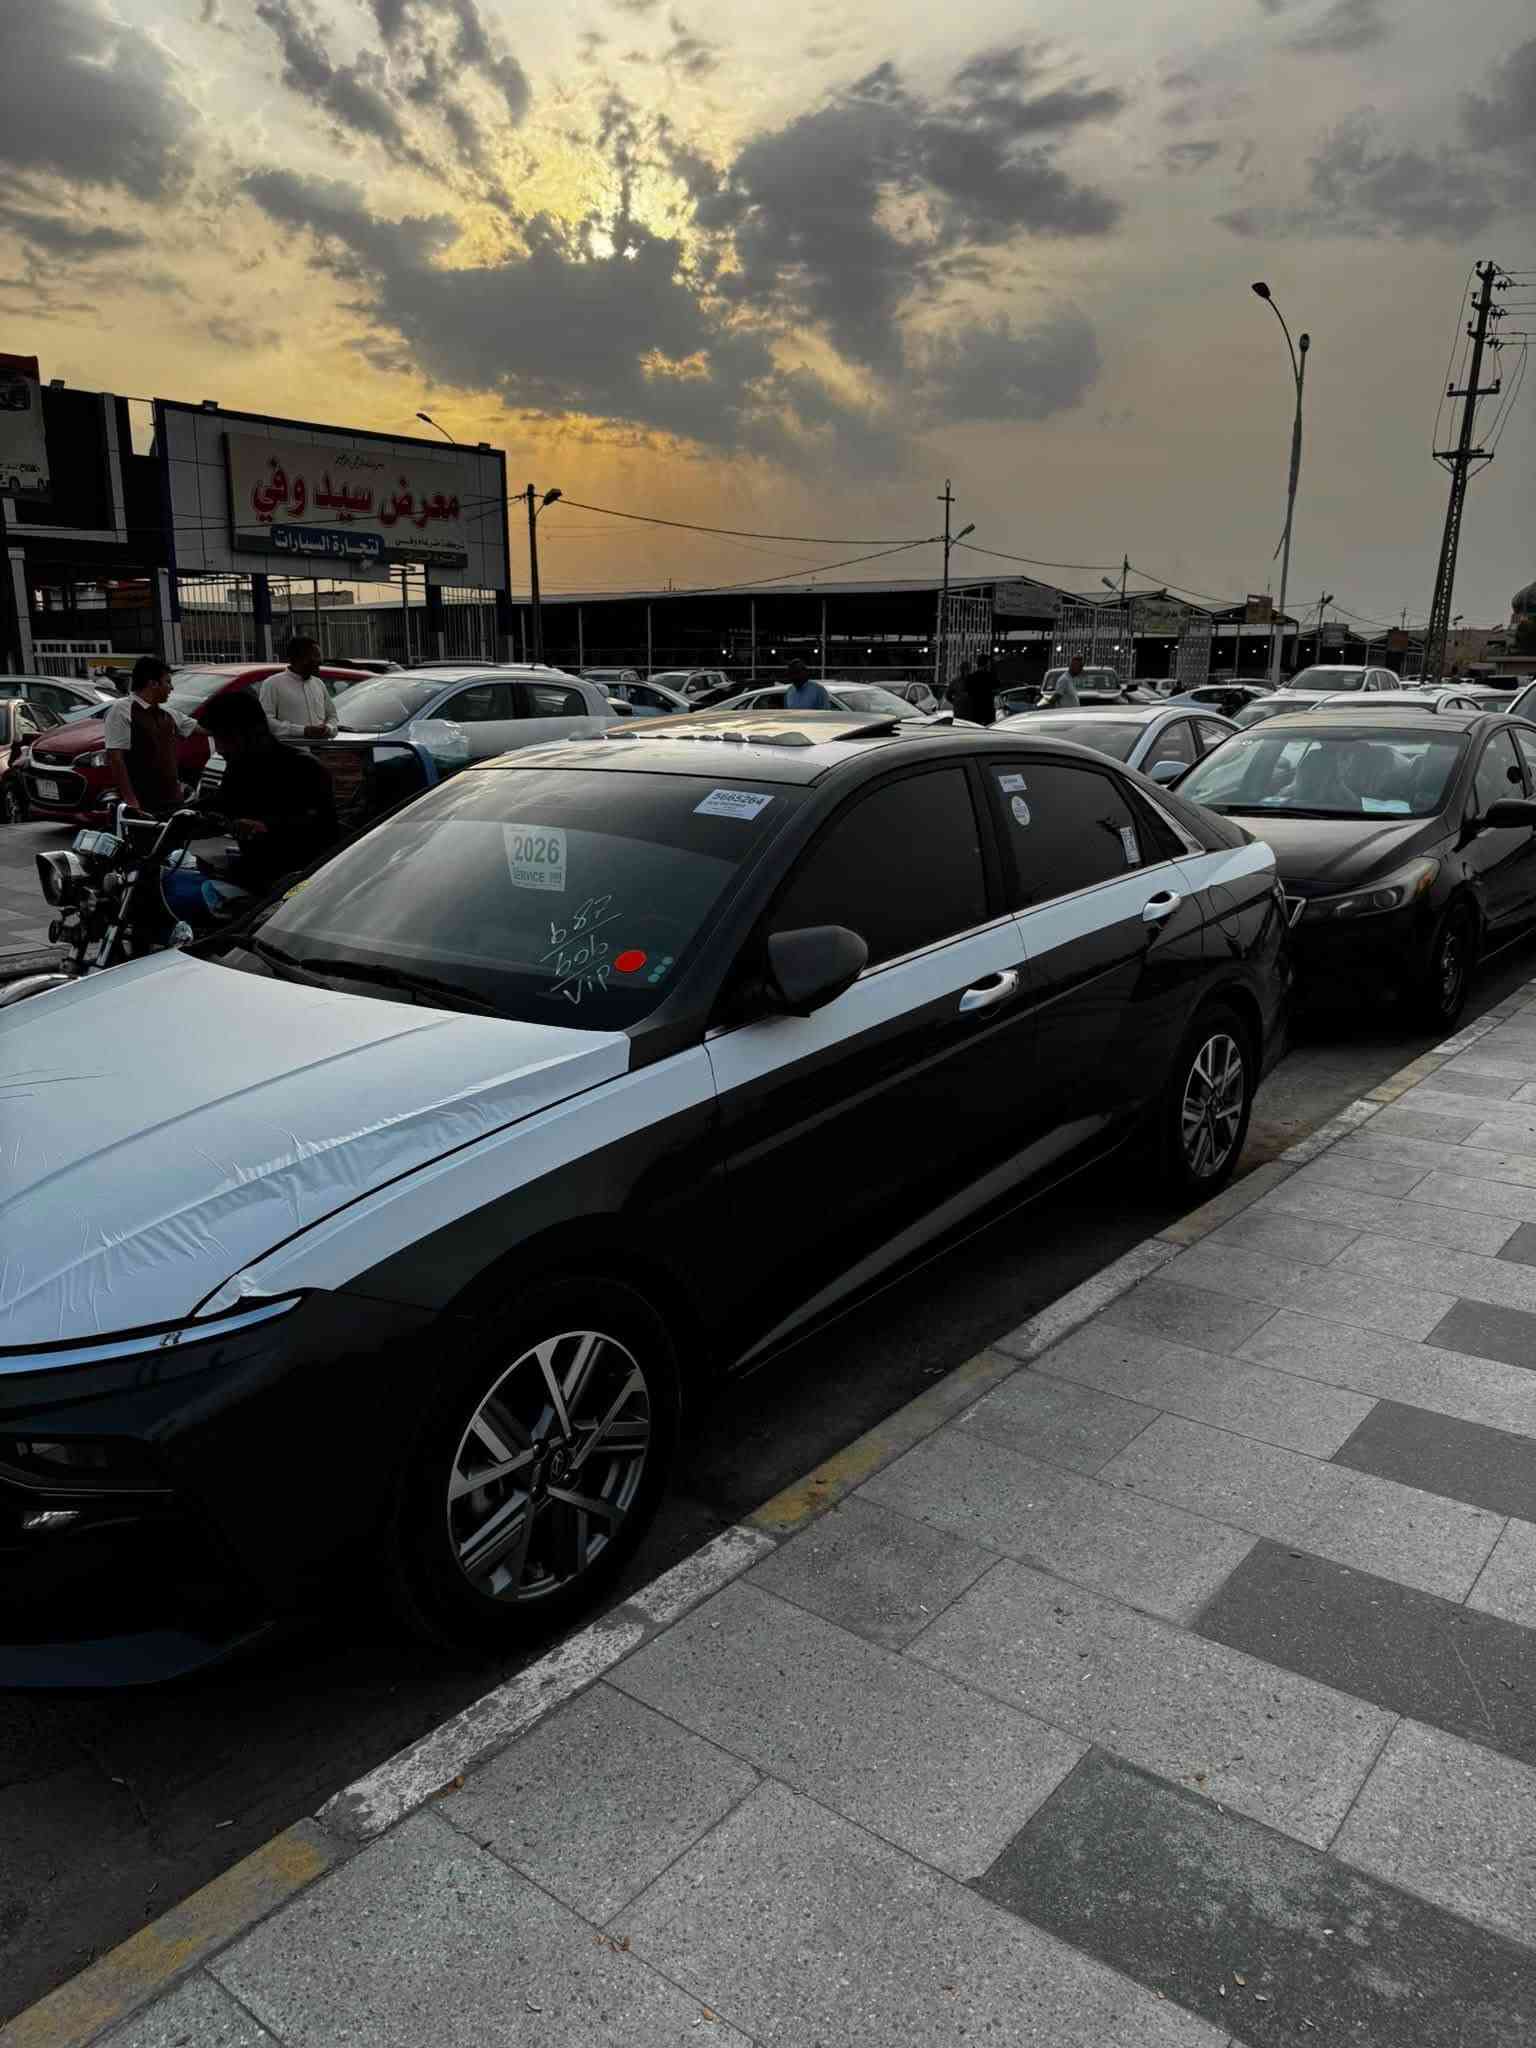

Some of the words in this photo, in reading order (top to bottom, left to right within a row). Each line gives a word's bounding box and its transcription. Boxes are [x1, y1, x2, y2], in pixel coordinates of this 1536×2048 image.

[313, 470, 374, 523] سيد
[378, 476, 460, 528] معرض
[274, 529, 331, 554] السيارات
[331, 535, 380, 558] لتجارة
[513, 835, 560, 864] 2026
[512, 870, 545, 882] SERVICE
